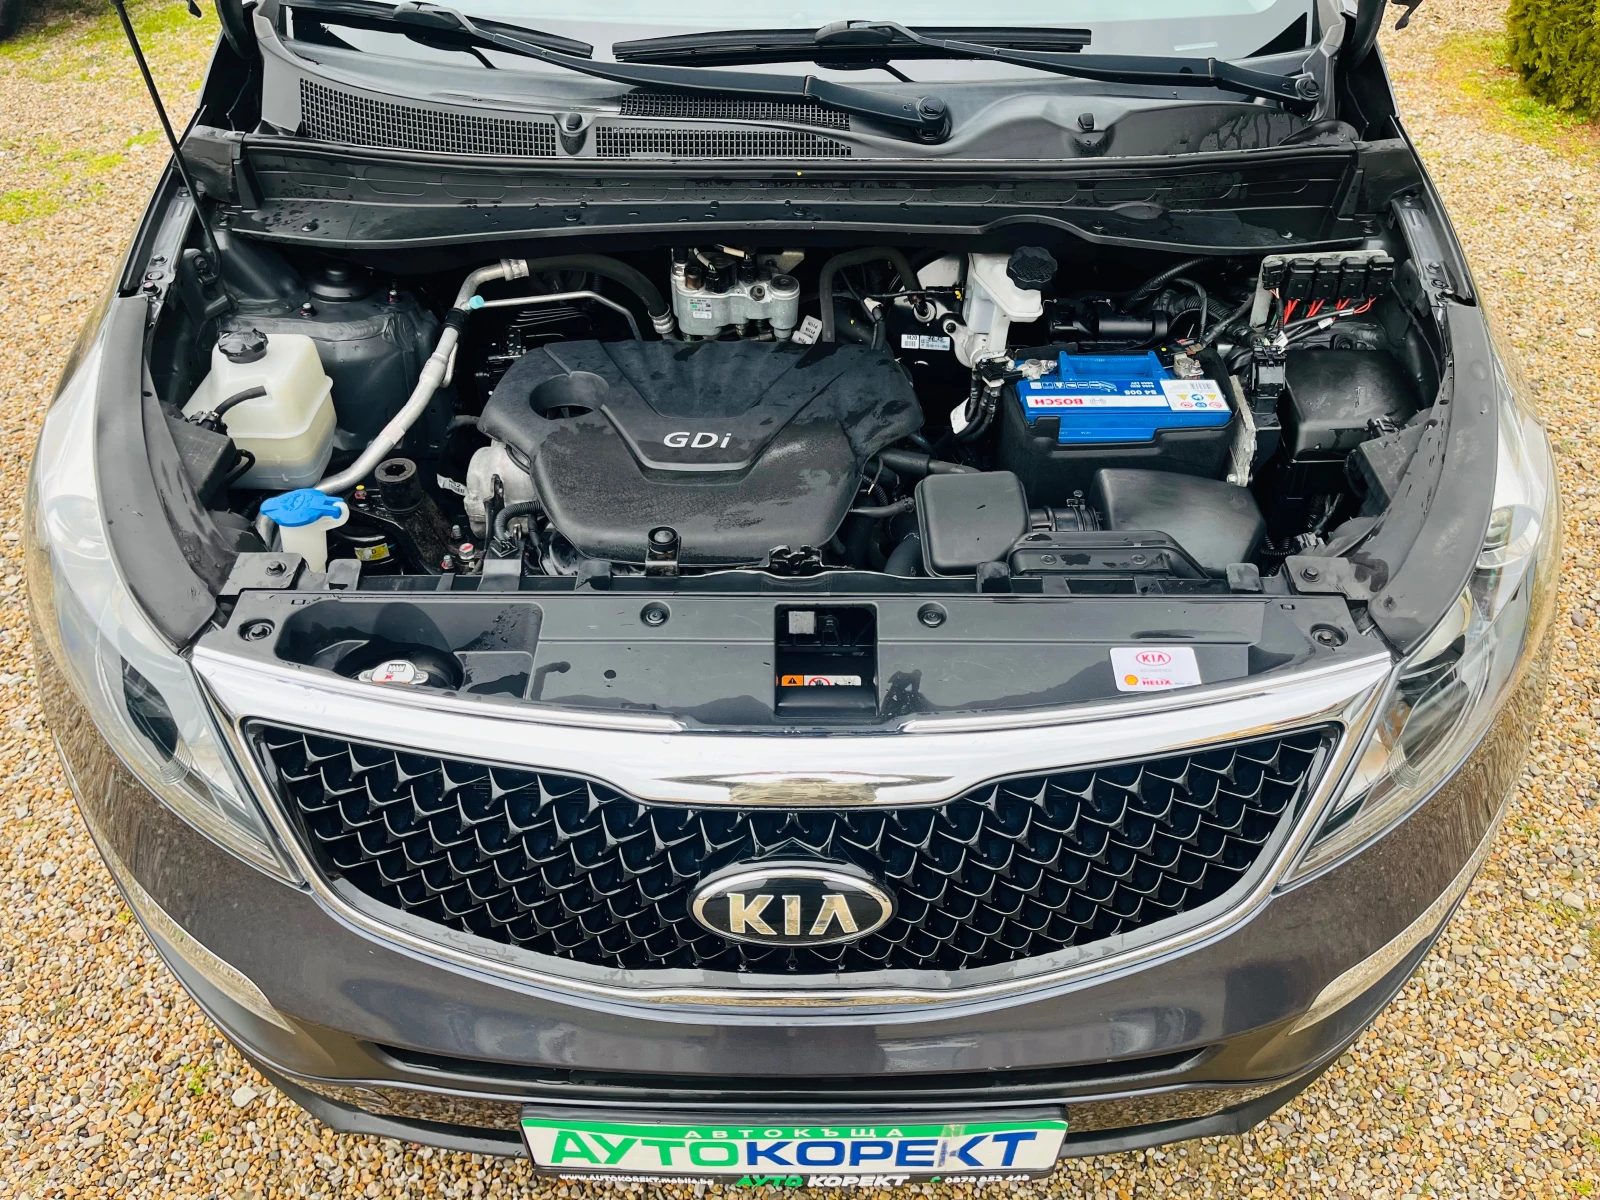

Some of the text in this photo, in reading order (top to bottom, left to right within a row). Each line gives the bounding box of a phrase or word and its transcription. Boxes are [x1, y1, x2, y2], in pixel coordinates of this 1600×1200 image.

[663, 431, 732, 449] GDi
[1141, 653, 1166, 663] KIA
[726, 892, 859, 936] KIA
[684, 1128, 904, 1139] АВТОКЪЩА
[550, 1130, 1038, 1167] АУТОКОРЕКТ
[735, 1174, 910, 1187] АУТО КОРЕКТ
